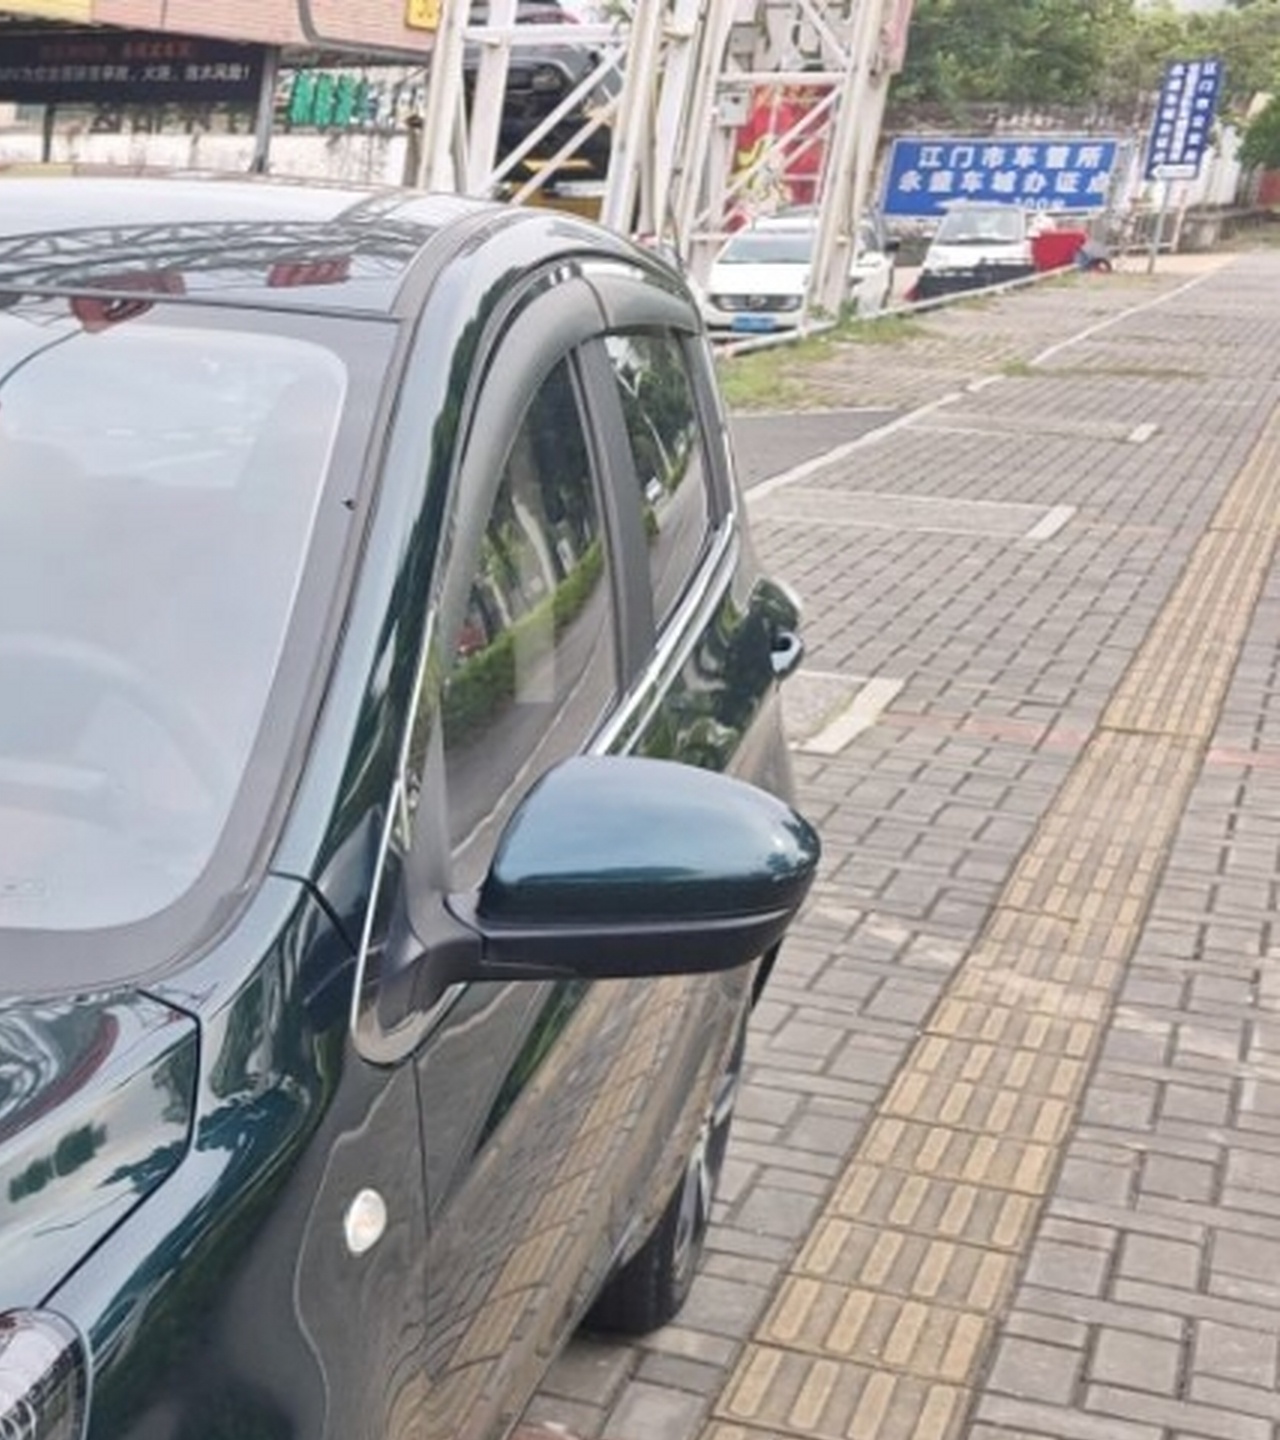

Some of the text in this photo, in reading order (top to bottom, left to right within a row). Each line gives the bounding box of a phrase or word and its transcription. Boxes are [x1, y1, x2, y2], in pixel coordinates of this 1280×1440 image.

[917, 145, 1104, 169] 江门市车管所
